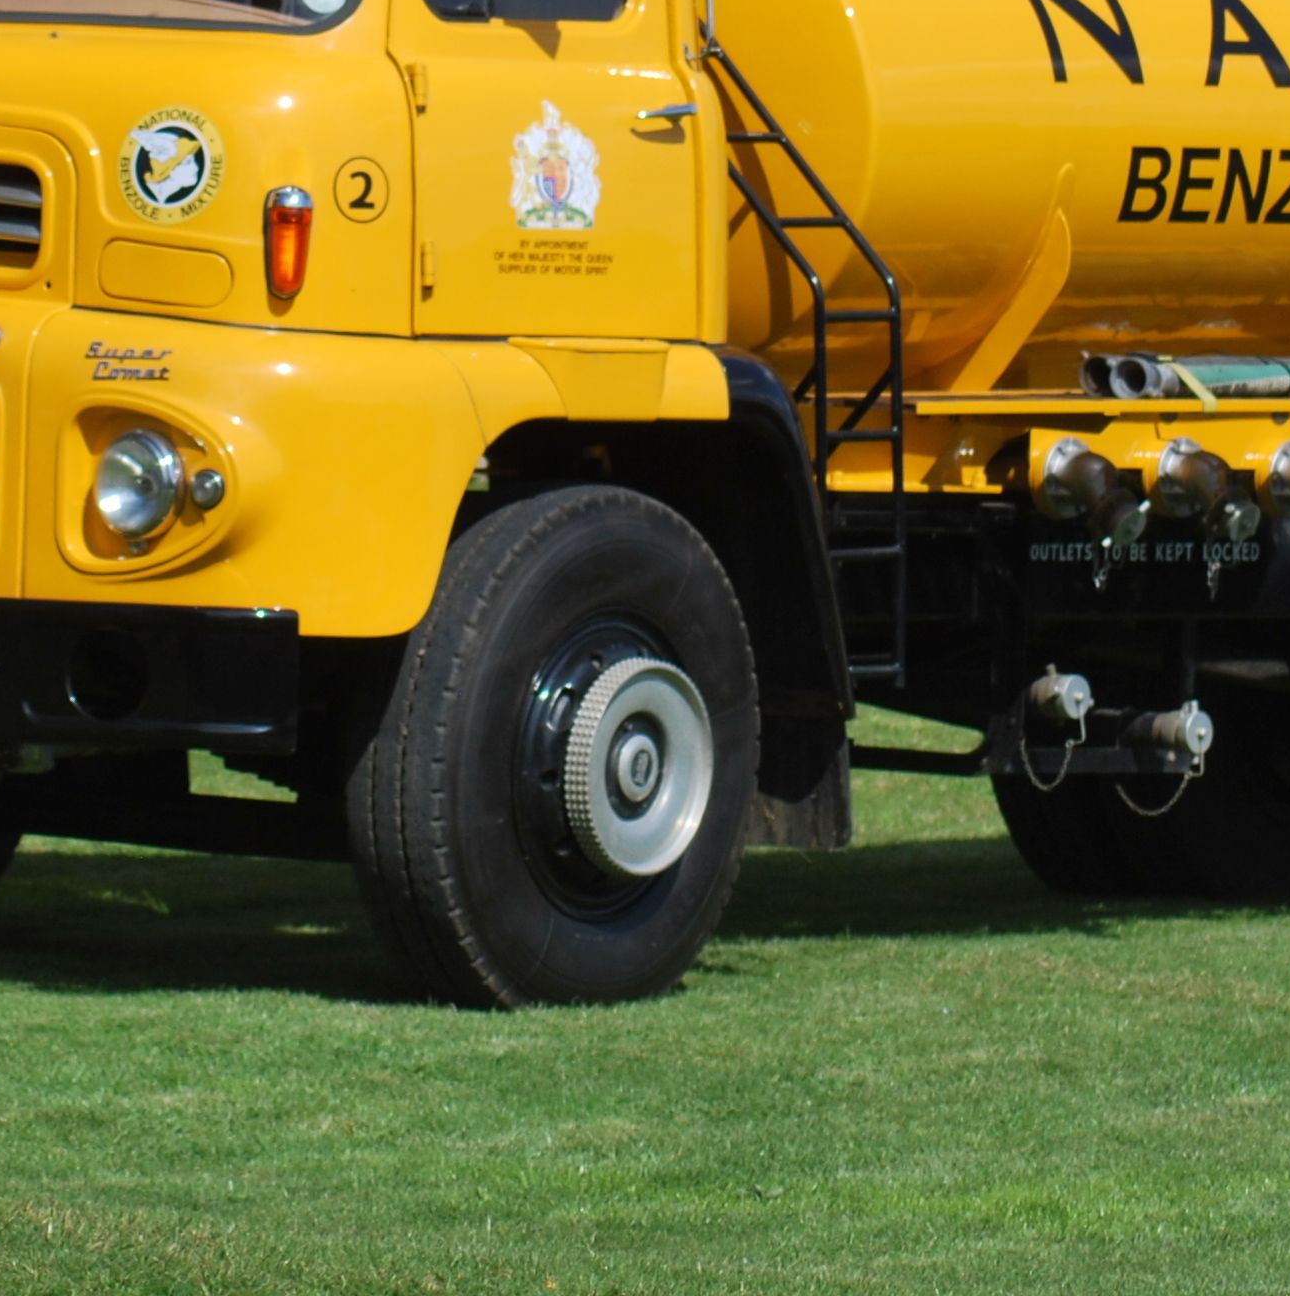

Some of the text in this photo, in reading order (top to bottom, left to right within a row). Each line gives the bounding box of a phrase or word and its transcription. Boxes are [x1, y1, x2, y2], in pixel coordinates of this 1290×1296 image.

[138, 108, 207, 132] NATIONAL
[119, 153, 223, 222] BENZOLE MIXTURE
[349, 170, 375, 209] 2
[85, 341, 173, 364] Super
[93, 361, 169, 381] Comet
[1030, 542, 1261, 562] OUTLETS TO BE KEPT LOCKED
